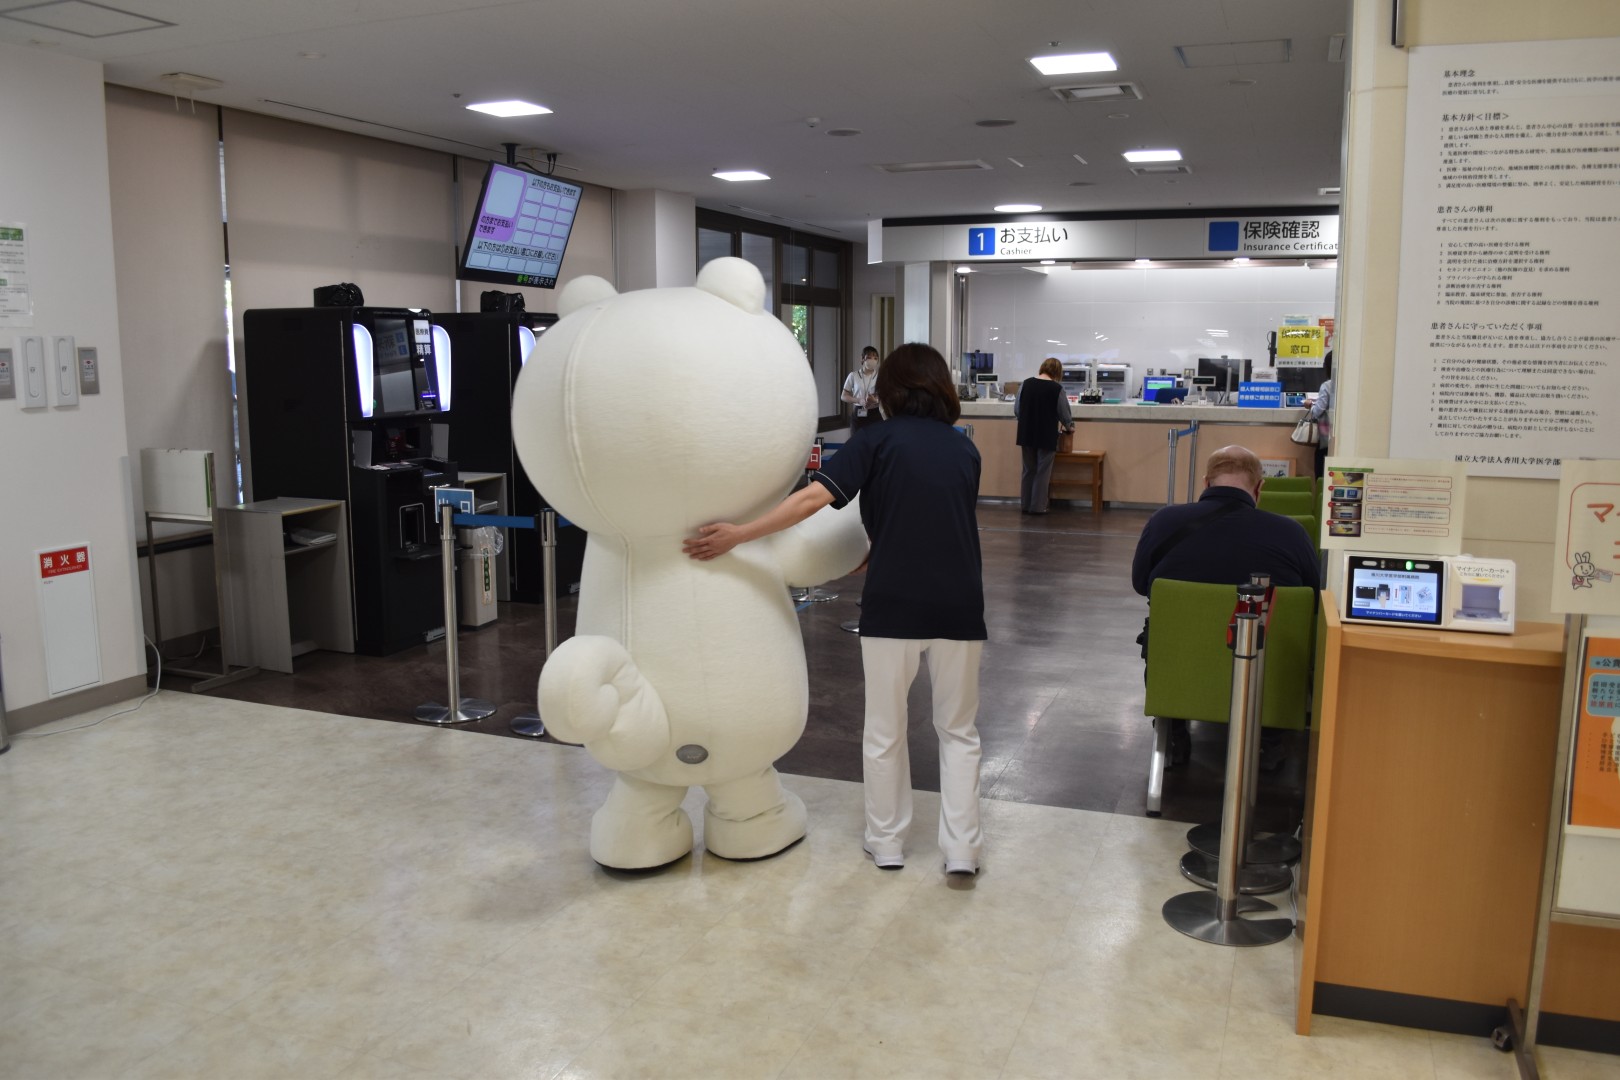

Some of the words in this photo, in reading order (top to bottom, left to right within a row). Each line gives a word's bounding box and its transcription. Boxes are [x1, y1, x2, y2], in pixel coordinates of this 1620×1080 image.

[1444, 70, 1476, 78] 基本理念
[1442, 112, 1510, 122] 基本方針＜目標＞
[1437, 205, 1493, 214] 患者さんの権利
[1243, 221, 1320, 239] 保険確認
[977, 232, 984, 251] 1
[1000, 226, 1068, 244] お支払い
[1431, 322, 1542, 331] 患者さんに守っていただく事項
[1281, 328, 1321, 339] 保険確認
[416, 344, 432, 356] 精算
[1290, 345, 1310, 354] 窓口
[1455, 455, 1561, 466] 国立大学法人香川大学医学部
[43, 552, 86, 568] 消火器
